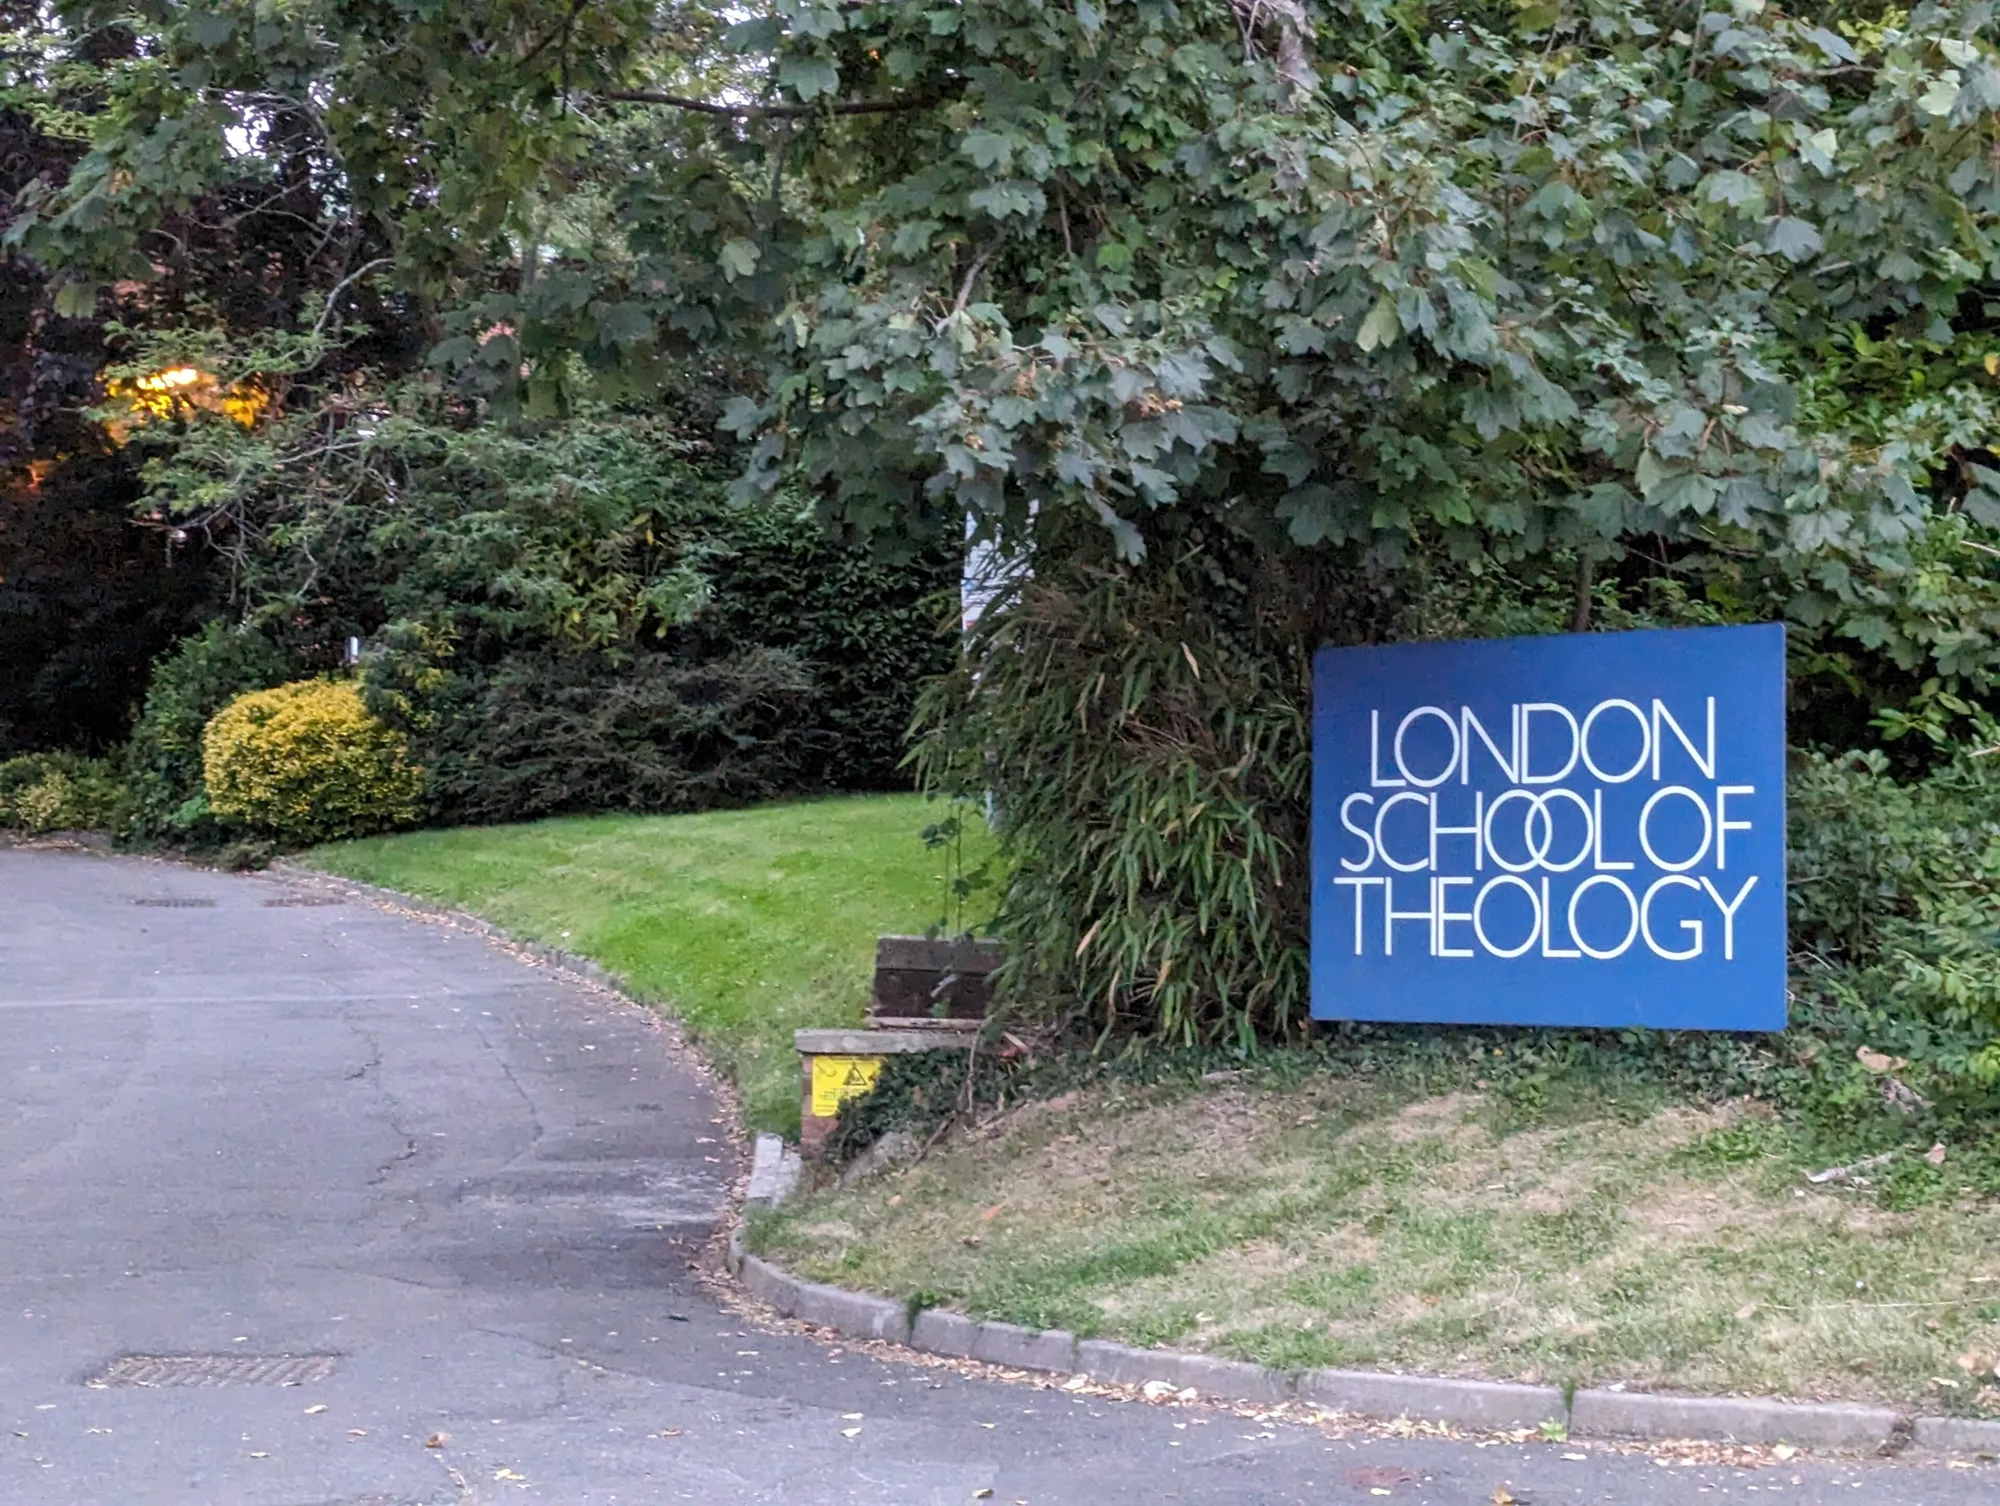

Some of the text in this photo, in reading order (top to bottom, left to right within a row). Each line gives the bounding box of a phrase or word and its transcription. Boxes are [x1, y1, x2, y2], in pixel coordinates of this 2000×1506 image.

[1371, 697, 1716, 788] LONDON
[1340, 785, 1755, 873] SCHOOL OF
[1334, 874, 1758, 962] THEOLOGY
